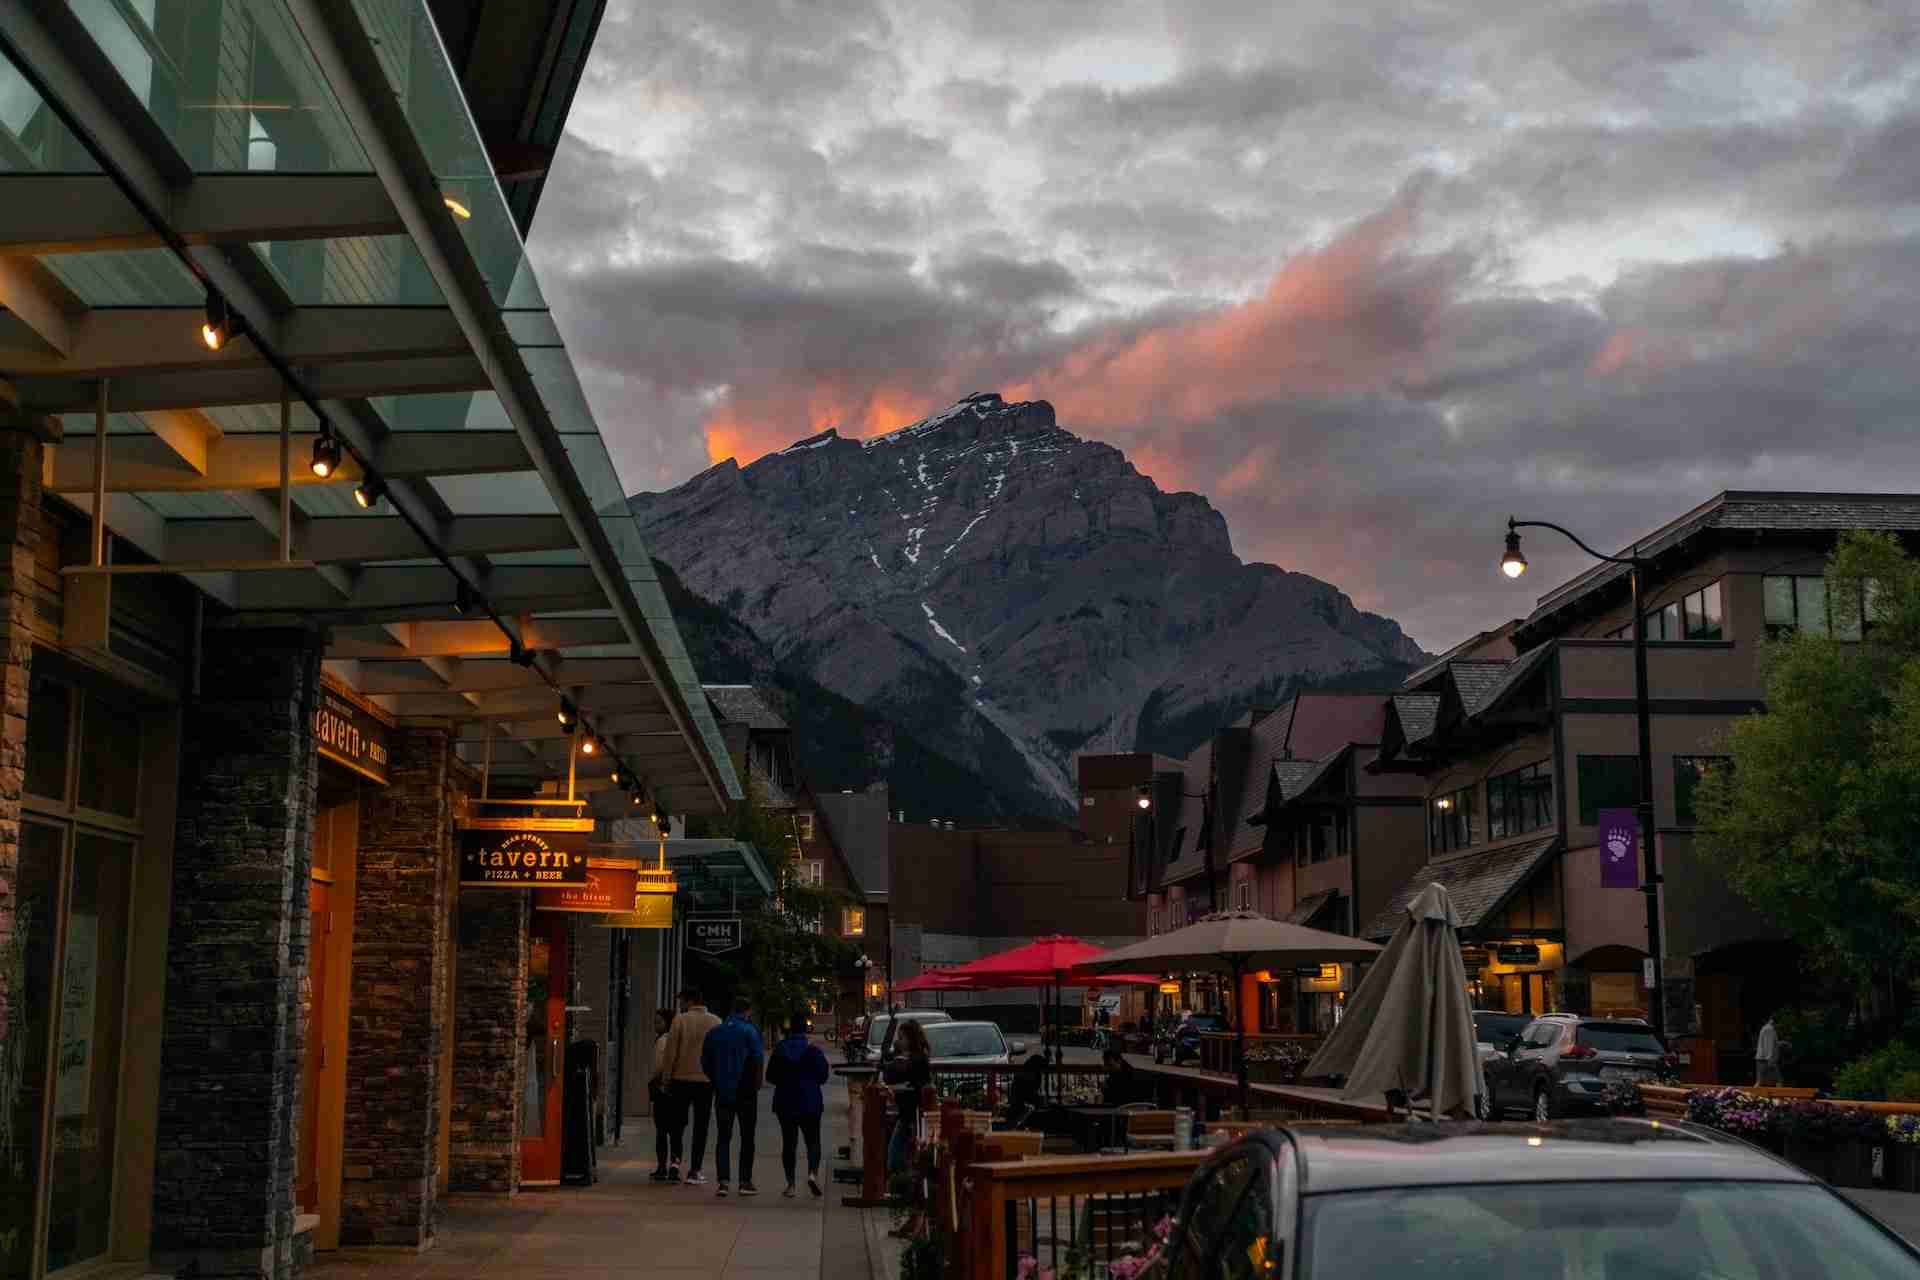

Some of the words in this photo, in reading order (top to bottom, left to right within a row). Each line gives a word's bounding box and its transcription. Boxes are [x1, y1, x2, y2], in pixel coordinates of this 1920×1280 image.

[479, 848, 569, 867] tavern
[485, 870, 518, 879] PIZZA
[536, 871, 562, 880] BEER
[696, 924, 731, 936] CMH
